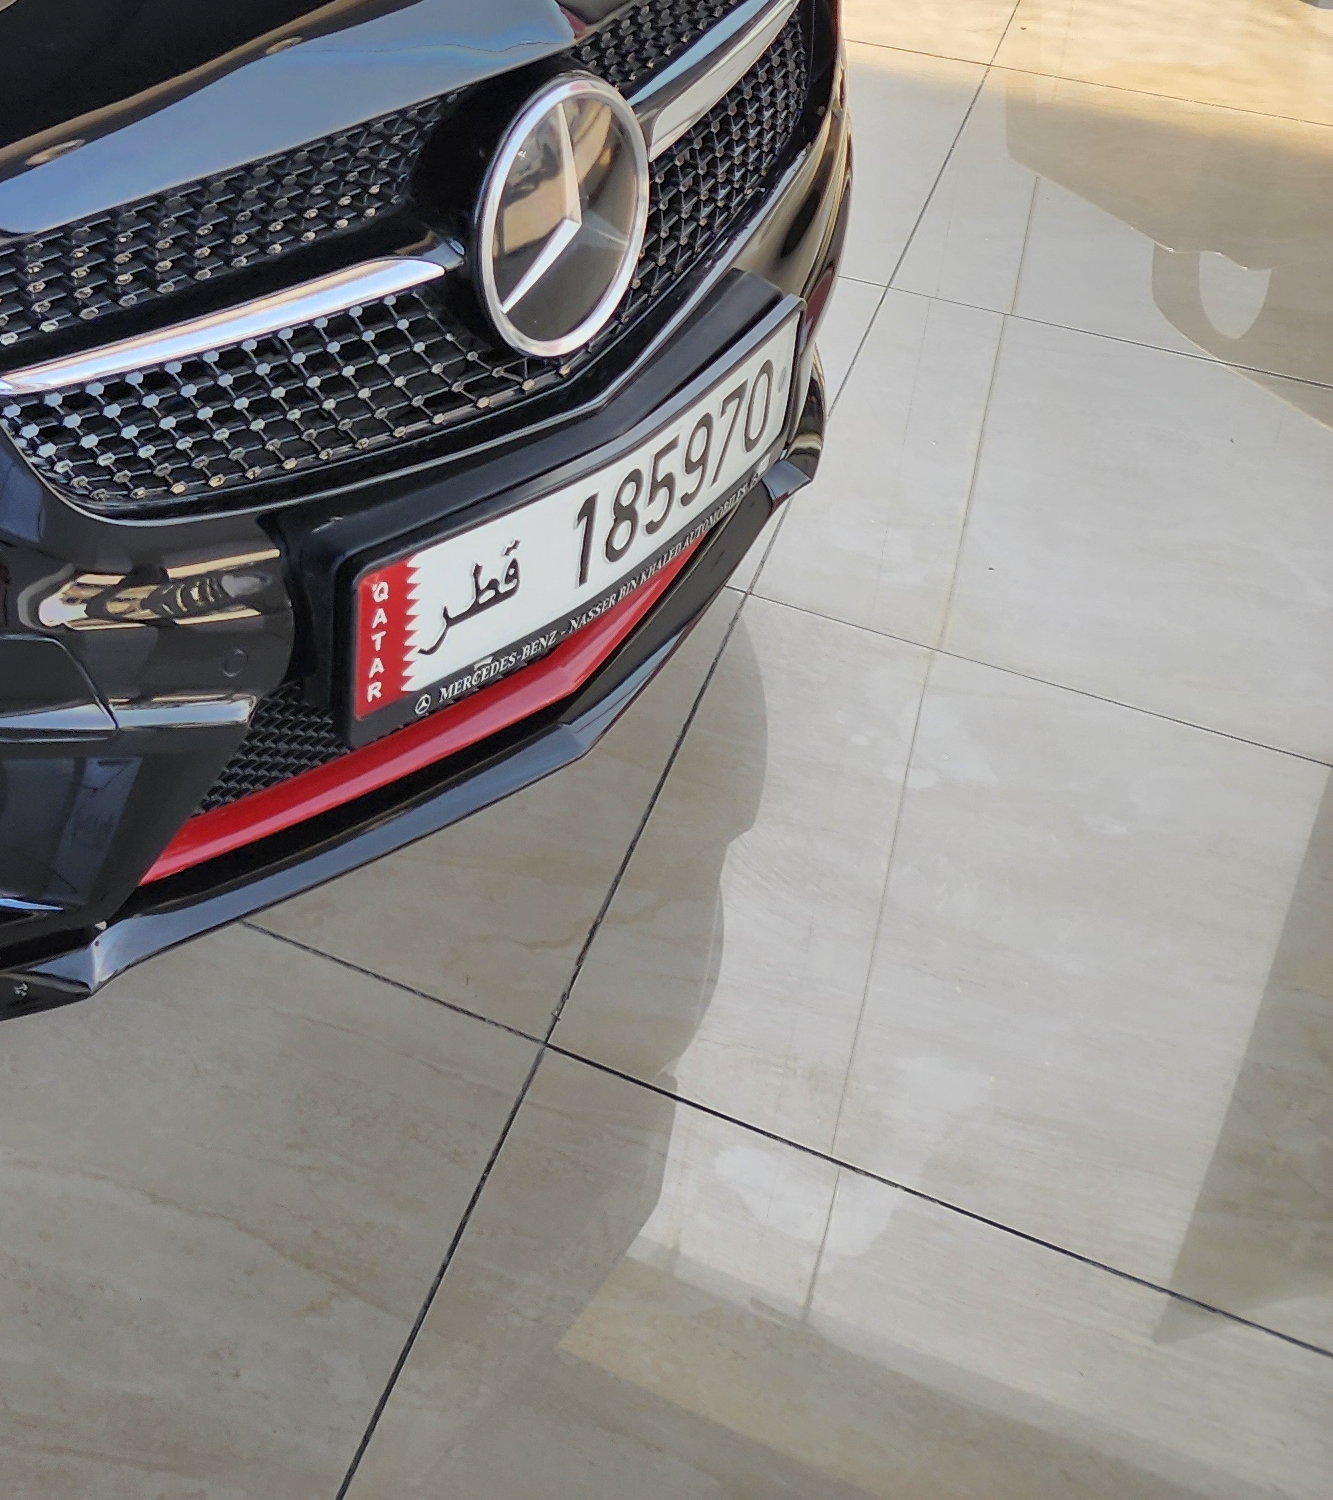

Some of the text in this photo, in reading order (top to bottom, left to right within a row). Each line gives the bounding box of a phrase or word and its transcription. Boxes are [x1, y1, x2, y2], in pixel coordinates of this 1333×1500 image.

[574, 358, 773, 588] 185970
[367, 581, 389, 703] QATAR
[418, 539, 521, 656] قطر
[439, 629, 557, 704] MERCEDES-BENZ
[568, 593, 617, 634] NASSER
[618, 578, 638, 603] BIN
